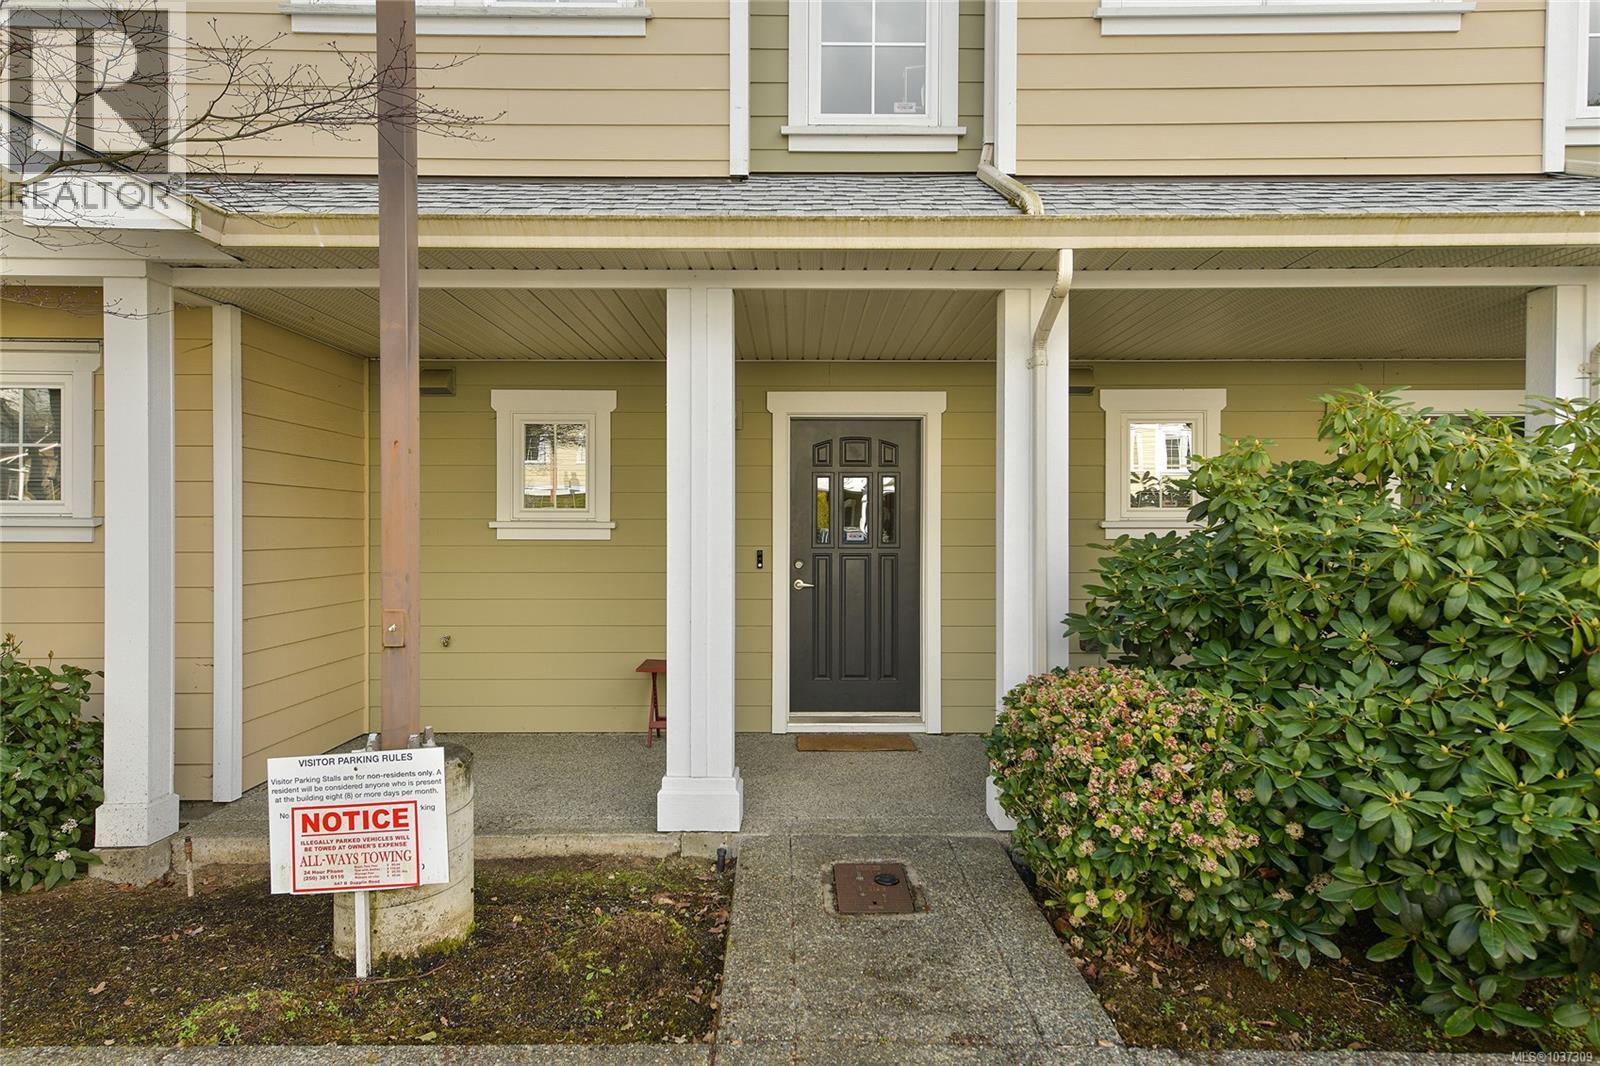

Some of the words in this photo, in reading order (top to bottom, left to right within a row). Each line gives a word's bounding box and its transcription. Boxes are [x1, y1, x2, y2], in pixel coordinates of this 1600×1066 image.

[298, 757, 335, 767] VISITOR
[337, 754, 380, 766] PARKING
[382, 753, 413, 763] RULES
[294, 776, 321, 784] Parking
[367, 770, 416, 779] non-residents
[418, 769, 435, 777] only.
[325, 783, 363, 791] considered
[364, 781, 390, 789] anyone
[416, 779, 442, 787] present
[296, 794, 324, 802] building
[325, 793, 343, 801] eight
[383, 790, 400, 798] days
[301, 807, 409, 833] NOTICE
[300, 838, 334, 846] ILLEGALLY
[362, 835, 393, 843] VEHICLES
[300, 852, 359, 867] ALL-WAYS
[361, 850, 413, 863] TOWING
